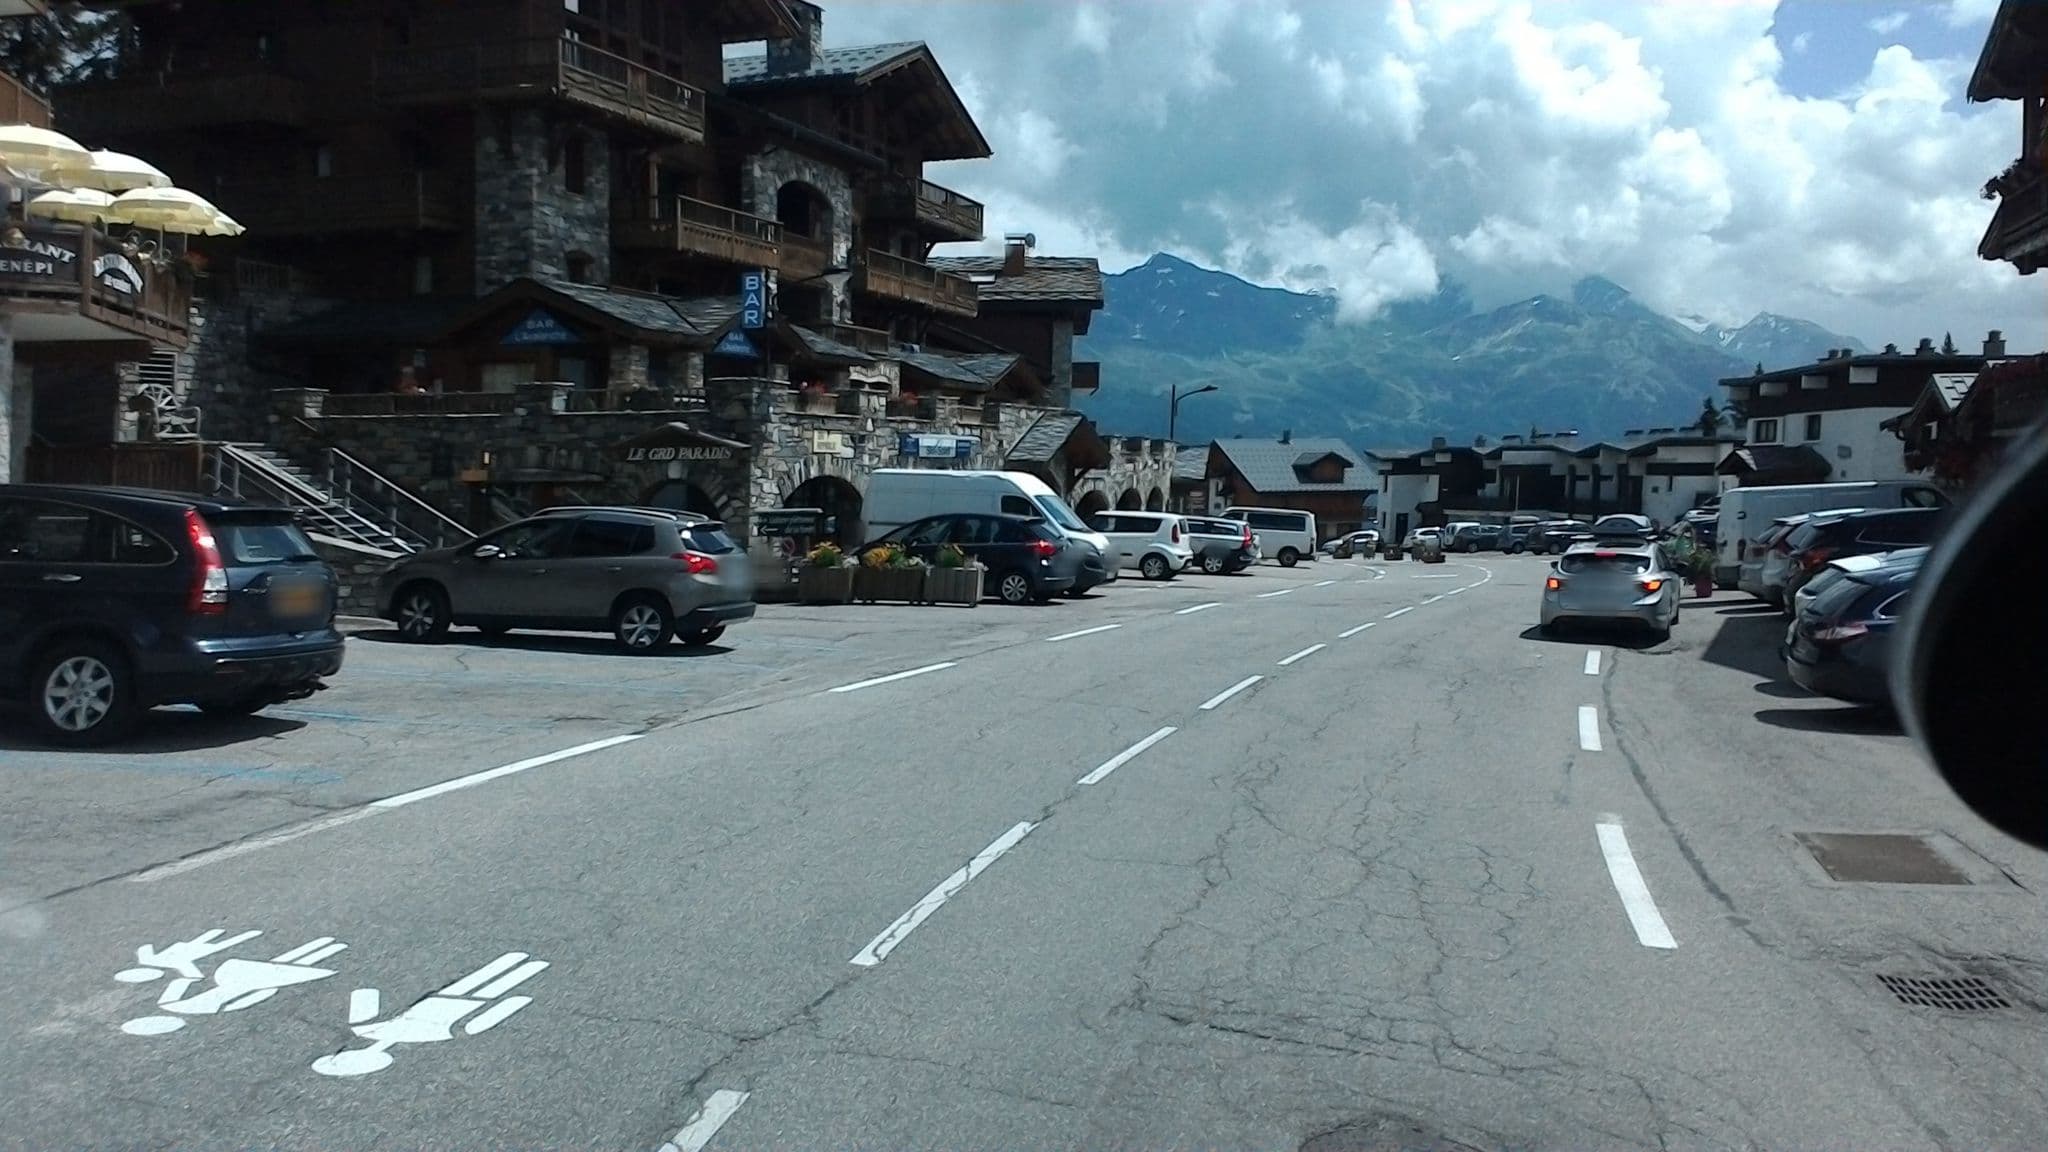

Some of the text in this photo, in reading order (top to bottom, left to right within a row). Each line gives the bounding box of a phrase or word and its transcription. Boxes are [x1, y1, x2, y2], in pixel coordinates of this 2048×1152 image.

[744, 275, 760, 325] BAR
[527, 319, 554, 329] BAR
[626, 446, 732, 461] LE GRD PARADIS
